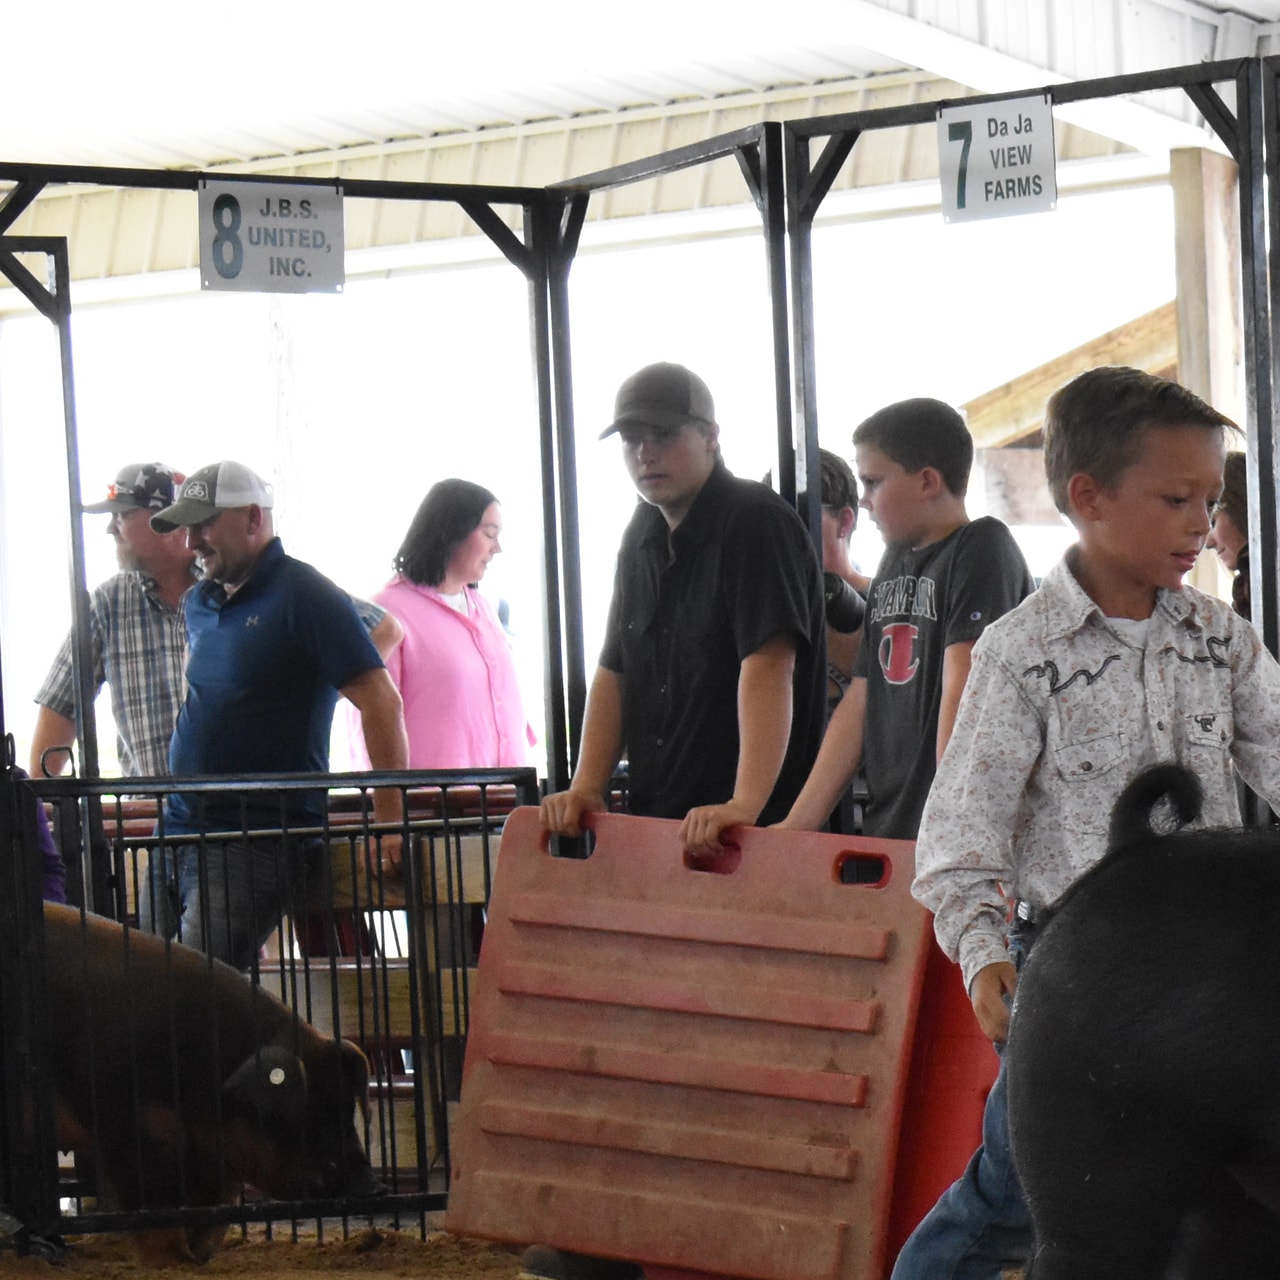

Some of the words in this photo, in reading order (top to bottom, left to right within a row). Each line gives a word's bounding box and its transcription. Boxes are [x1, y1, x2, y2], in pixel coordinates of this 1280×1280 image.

[987, 117, 1009, 139] Da
[1013, 113, 1033, 135] Ja
[948, 120, 973, 210] 7
[989, 143, 1033, 170] VIEW
[984, 174, 1043, 202] FARMS
[259, 197, 319, 220] J.B.S.
[212, 193, 244, 280] 8
[247, 226, 332, 253] UNITED,
[269, 256, 313, 278] INC.
